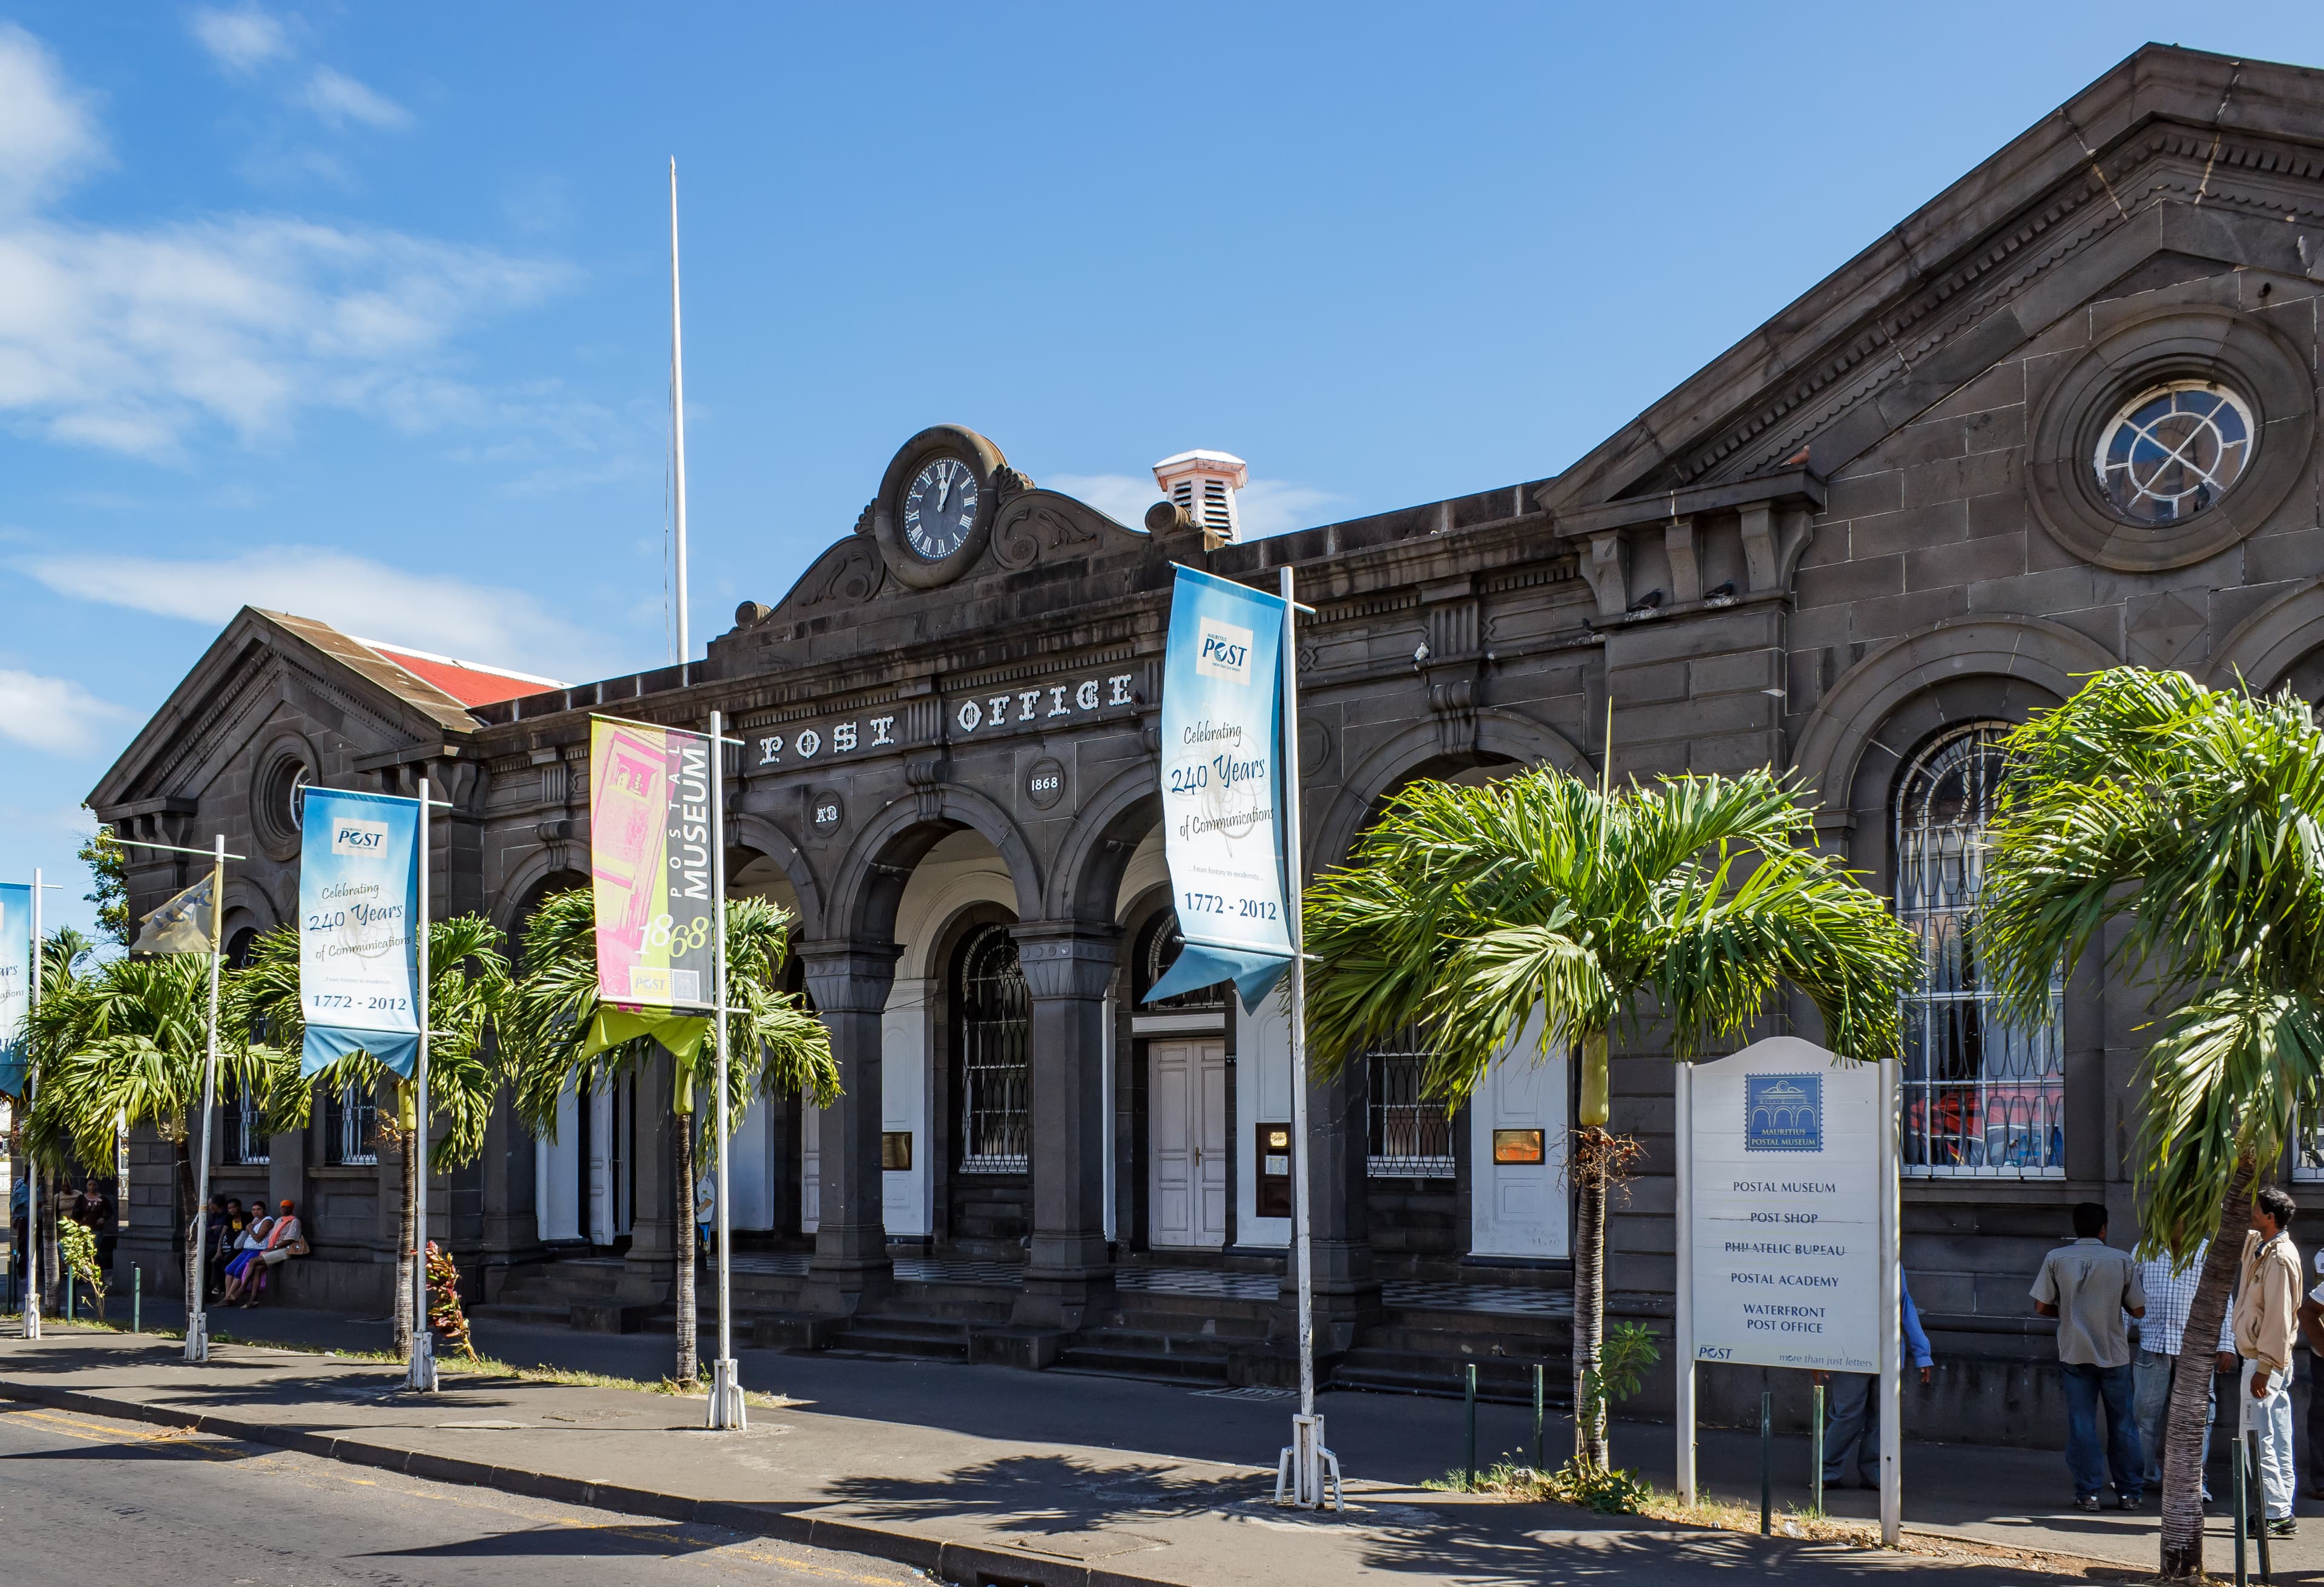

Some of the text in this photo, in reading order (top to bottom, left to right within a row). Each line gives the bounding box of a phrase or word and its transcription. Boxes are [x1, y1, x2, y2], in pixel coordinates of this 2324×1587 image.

[1203, 638, 1247, 667] POST
[759, 673, 1132, 765] POST OFFICE
[1184, 720, 1241, 747] Celebrating
[1172, 754, 1265, 795] 240 Years
[1031, 777, 1058, 791] 1868
[668, 745, 682, 898] POSTAL
[816, 805, 838, 823] AD
[682, 748, 708, 901] MUSEUM
[1180, 806, 1274, 841] of Communications
[338, 830, 383, 846] POST
[1208, 866, 1226, 877] history
[322, 883, 379, 900] Celebrating
[1185, 892, 1224, 914] 1772
[1239, 898, 1276, 920] 2012
[309, 903, 402, 932] 240 Years
[634, 914, 709, 958] 1868
[316, 936, 411, 962] of Communications
[635, 977, 666, 990] POST
[313, 995, 352, 1007] 1772
[368, 997, 406, 1010] 2012
[1733, 1182, 1836, 1193] POSTAL MUSEUM
[1751, 1212, 1818, 1223] POST SHOP
[1725, 1242, 1845, 1256] PHILATELIC BUREAU
[1731, 1272, 1839, 1287] POSTAL ACADEMY
[1743, 1303, 1826, 1318] WATERFRONT
[1747, 1319, 1822, 1333] POST OFFICE
[1698, 1347, 1733, 1360] POST
[1805, 1353, 1824, 1364] than
[1827, 1356, 1842, 1366] just
[1846, 1357, 1873, 1367] letters
